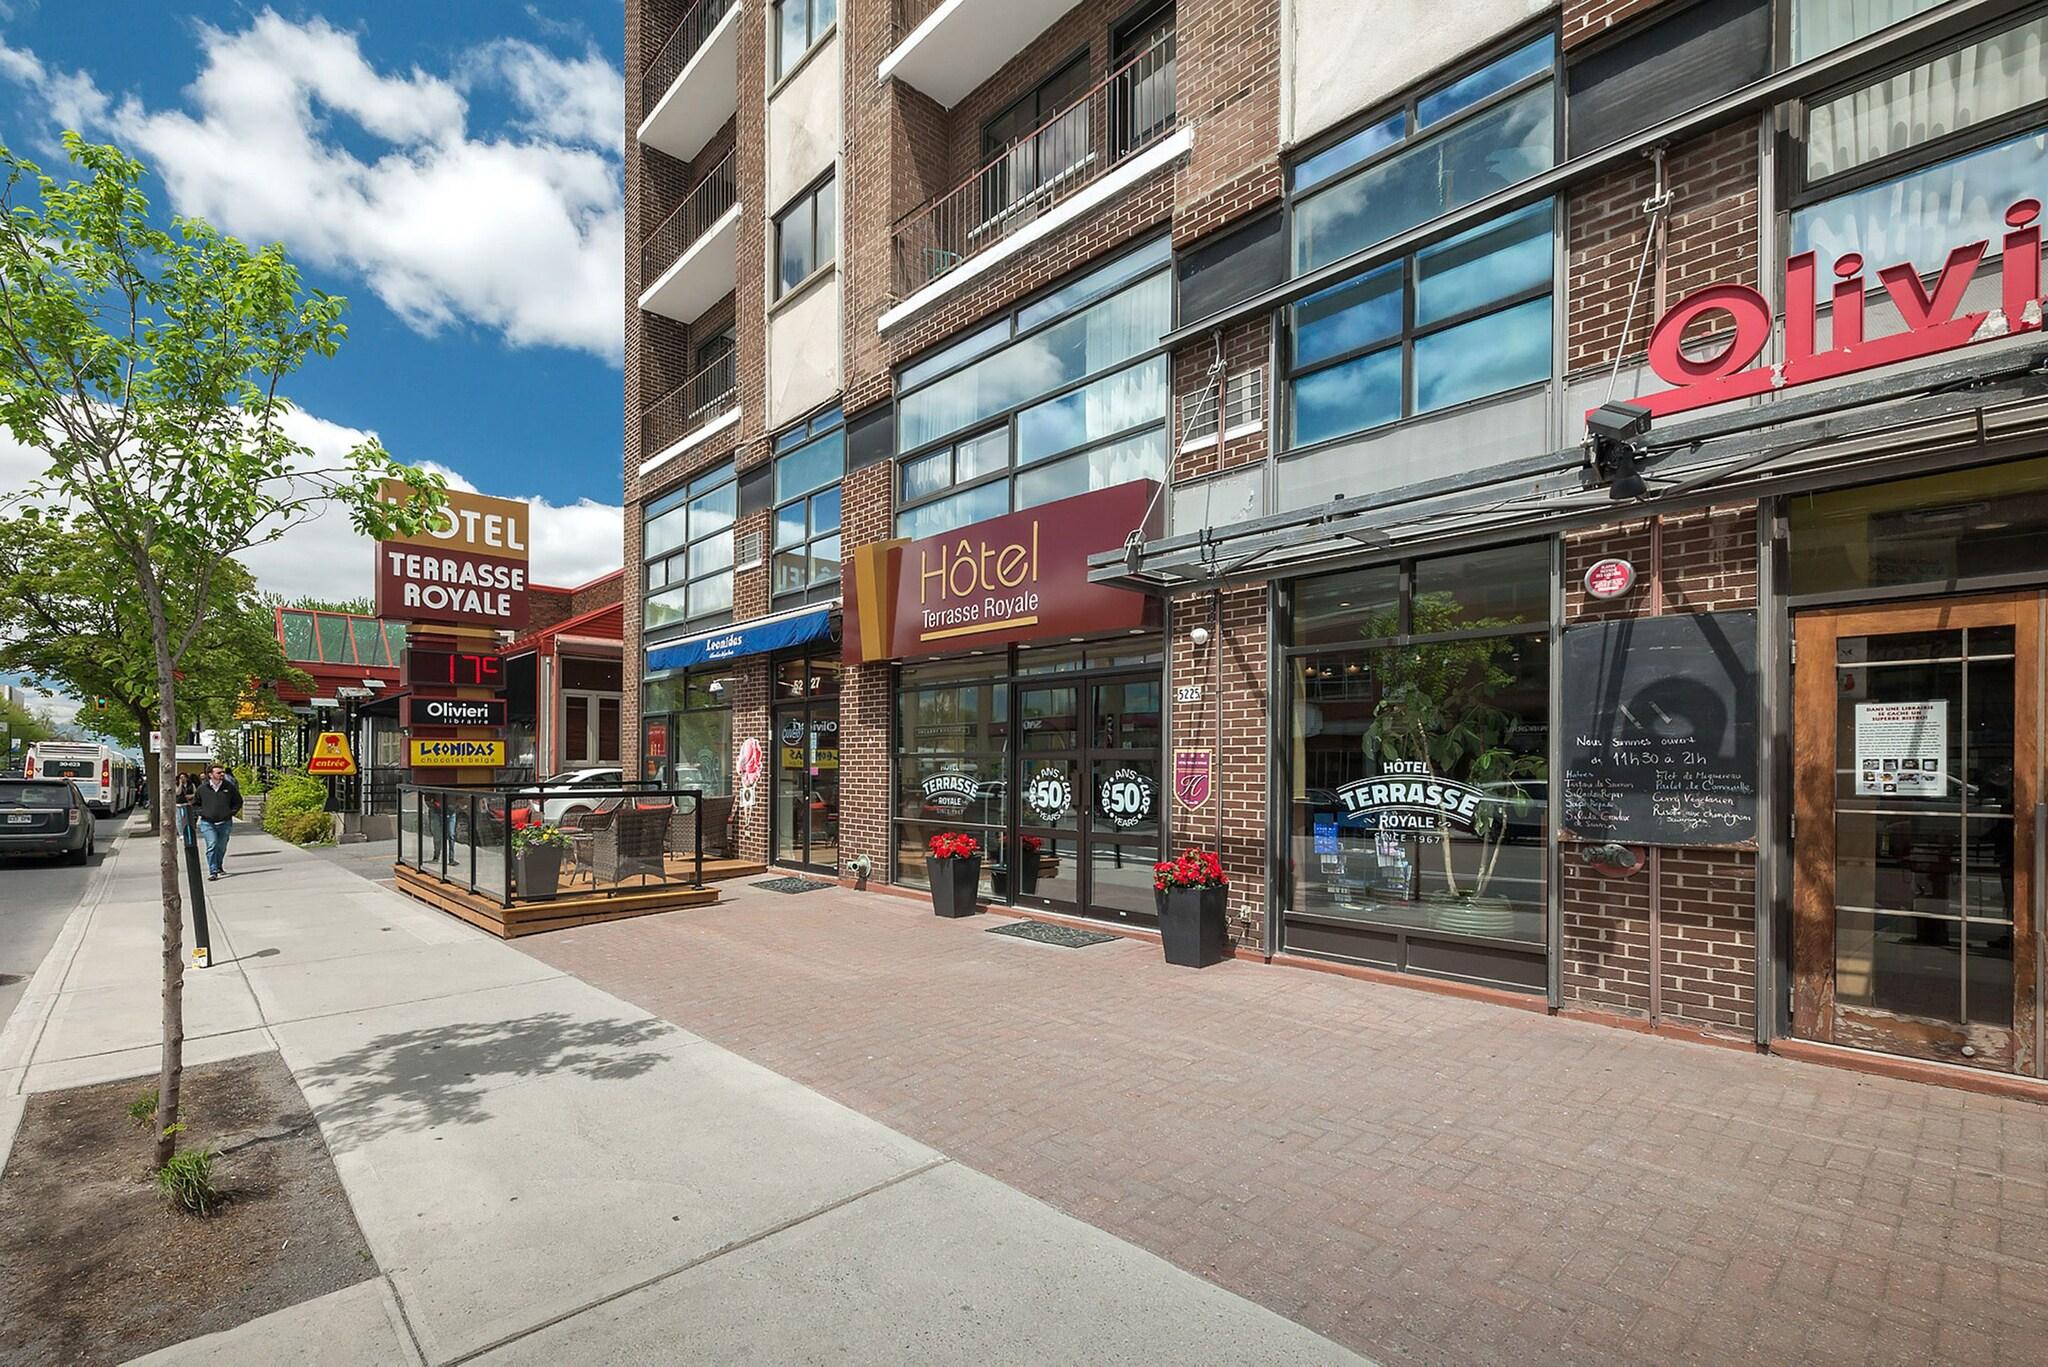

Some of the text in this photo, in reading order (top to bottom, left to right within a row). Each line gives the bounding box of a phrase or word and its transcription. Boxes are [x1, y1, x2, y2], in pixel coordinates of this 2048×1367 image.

[921, 520, 1038, 604] Hôtel
[388, 552, 524, 592] TERRASSE
[404, 582, 511, 617] ROYALE
[922, 591, 1038, 628] Terrasse Royale
[427, 702, 488, 717] Olivieri
[420, 742, 495, 756] LEONIDAS
[1682, 751, 1706, 764] 21h
[1041, 768, 1060, 778] ANS
[1384, 758, 1430, 774] HÔTEL
[1115, 768, 1137, 780] ANS
[923, 776, 979, 798] TERRASSE
[1037, 780, 1063, 808] 50
[938, 797, 961, 805] ROYALE
[1111, 783, 1140, 813] 50
[1340, 783, 1481, 817] TERRASSE
[1040, 811, 1061, 821] YEARS
[1114, 815, 1139, 827] YEARS
[1380, 815, 1434, 829] ROYALE
[1374, 832, 1441, 844] SINCE 1967
